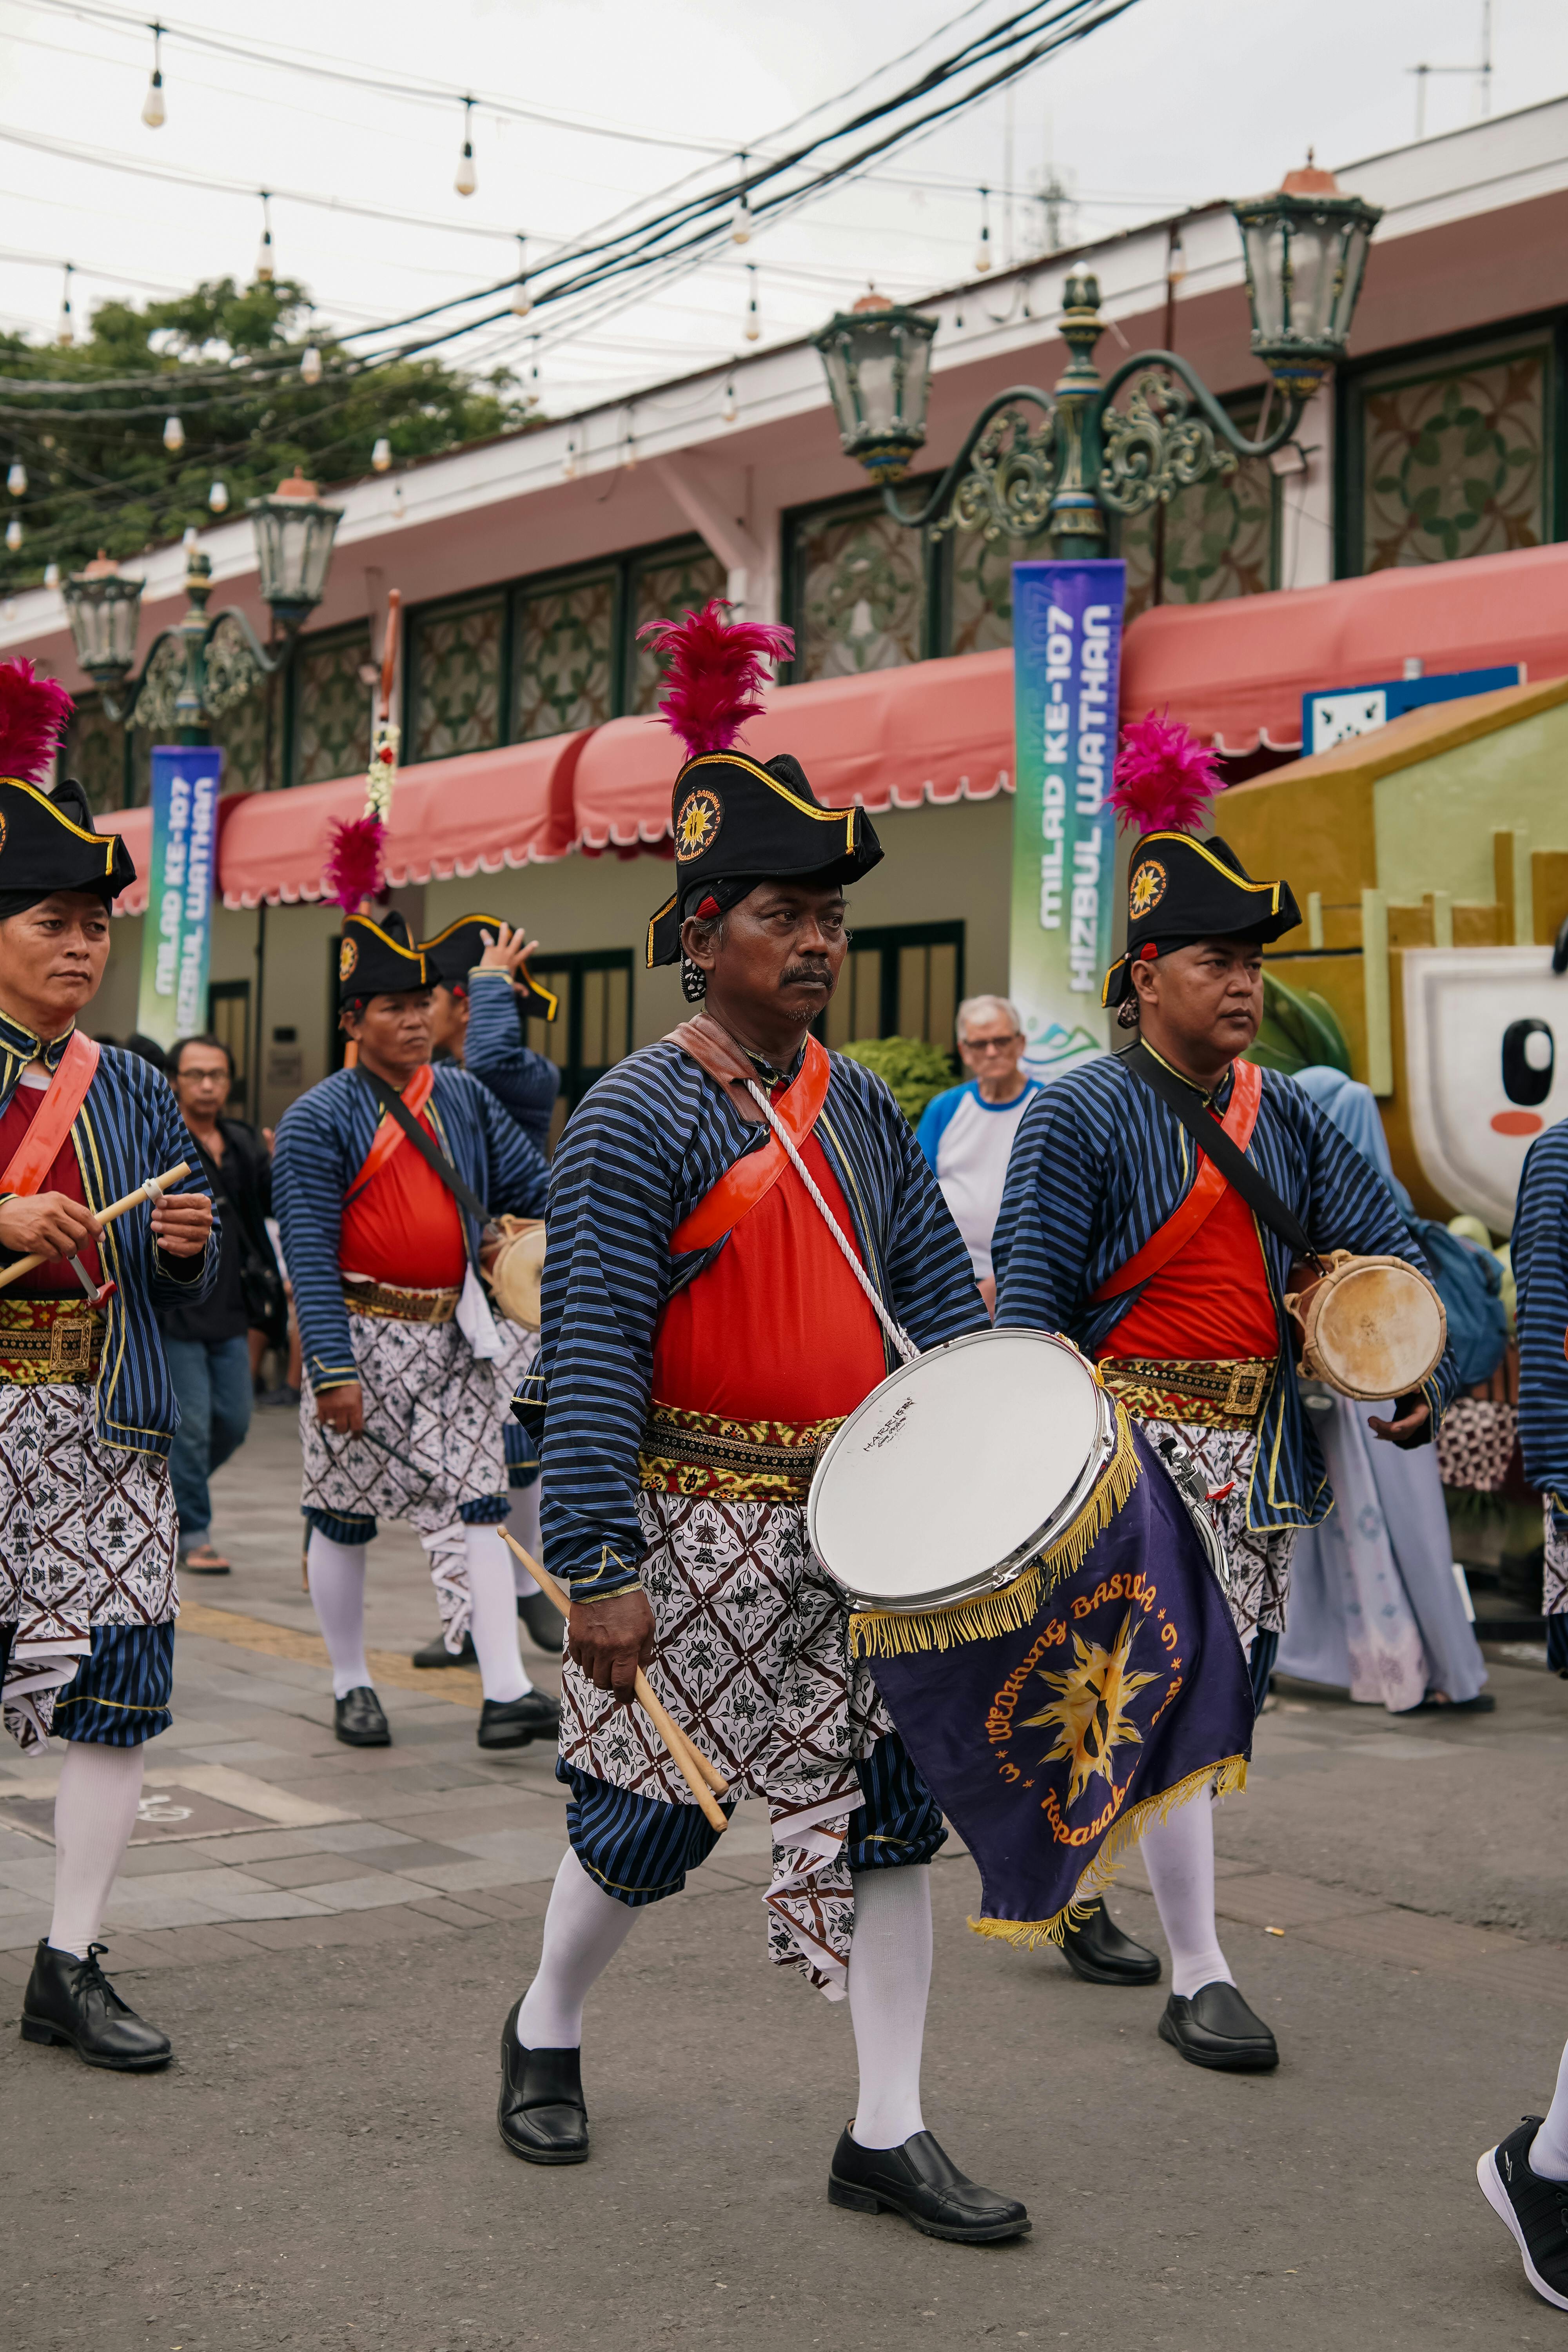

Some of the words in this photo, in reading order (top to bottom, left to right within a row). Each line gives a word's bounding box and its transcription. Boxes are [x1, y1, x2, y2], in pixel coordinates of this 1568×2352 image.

[1044, 605, 1074, 764] KE-107
[1075, 605, 1111, 815] WATHAN
[164, 777, 191, 886] KE-107
[1040, 775, 1066, 928] MILAD
[156, 891, 182, 995] MILAD
[1070, 828, 1102, 991] HIZBUL
[1161, 1622, 1178, 1651] 9
[999, 1762, 1021, 1783] 3
